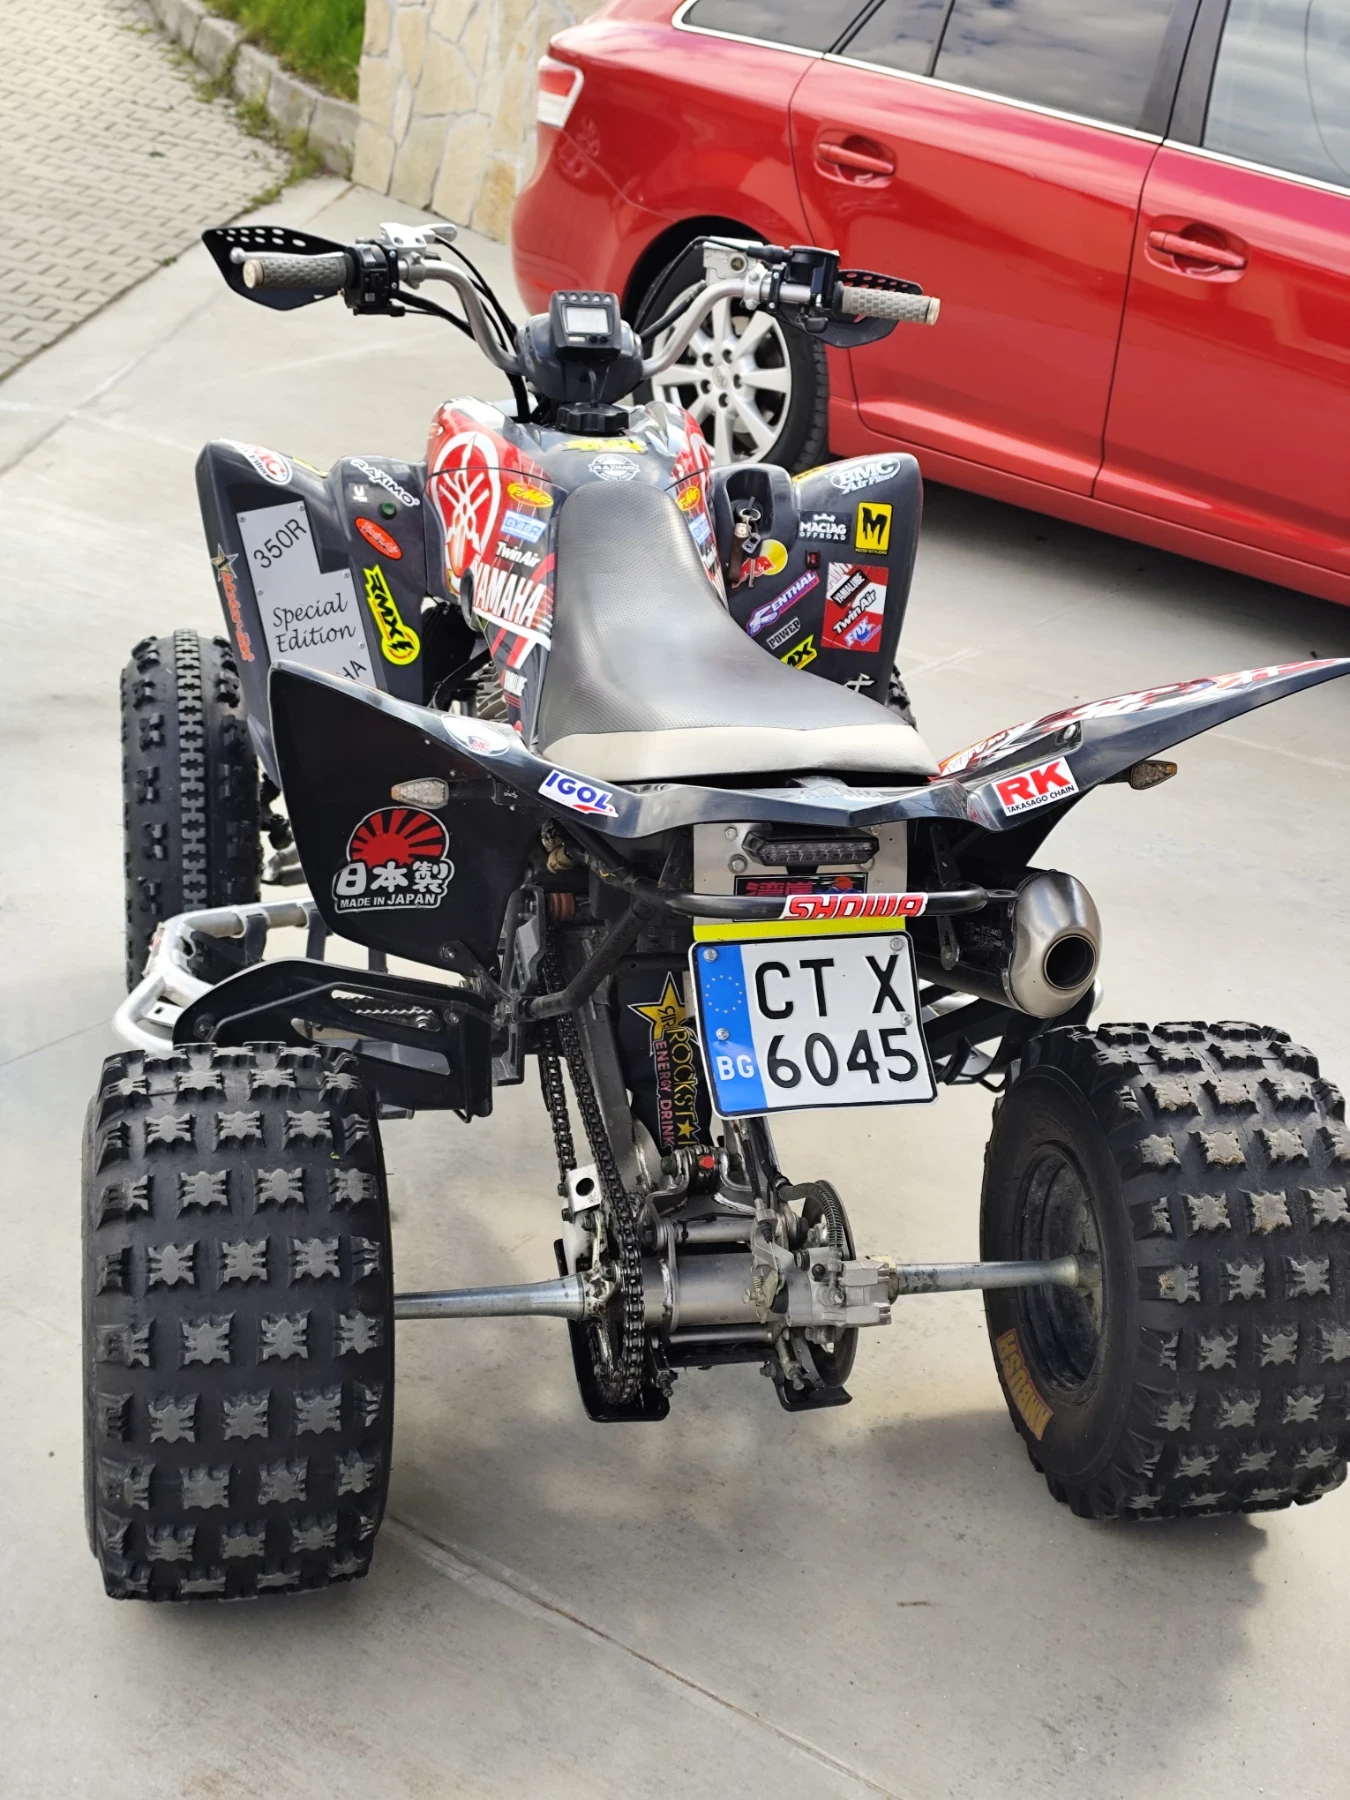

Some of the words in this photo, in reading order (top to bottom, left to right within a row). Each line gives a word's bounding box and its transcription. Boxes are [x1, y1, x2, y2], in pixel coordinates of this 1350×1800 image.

[838, 459, 897, 486] BMC
[253, 518, 307, 569] 350R
[800, 521, 847, 535] MACIAG
[800, 531, 846, 541] OFFROAD
[472, 560, 547, 629] YAMAHA
[832, 571, 866, 604] YAMALUBE
[272, 592, 348, 631] Special
[275, 624, 356, 653] Edition
[546, 772, 609, 810] IGOL
[995, 760, 1072, 806] RK
[1006, 794, 1049, 814] TAKASAGO
[1049, 784, 1075, 800] CHAIN
[335, 861, 449, 896] 日本製
[340, 897, 371, 908] MADE
[373, 896, 385, 906] IN
[386, 893, 436, 905] JAPAN
[783, 894, 924, 920] SHOWA
[754, 958, 834, 1020] CT
[865, 954, 906, 1015] X
[655, 1040, 672, 1093] ENERGY
[716, 1054, 755, 1081] BG
[766, 1027, 919, 1090] 6045
[659, 1099, 676, 1148] DRINK
